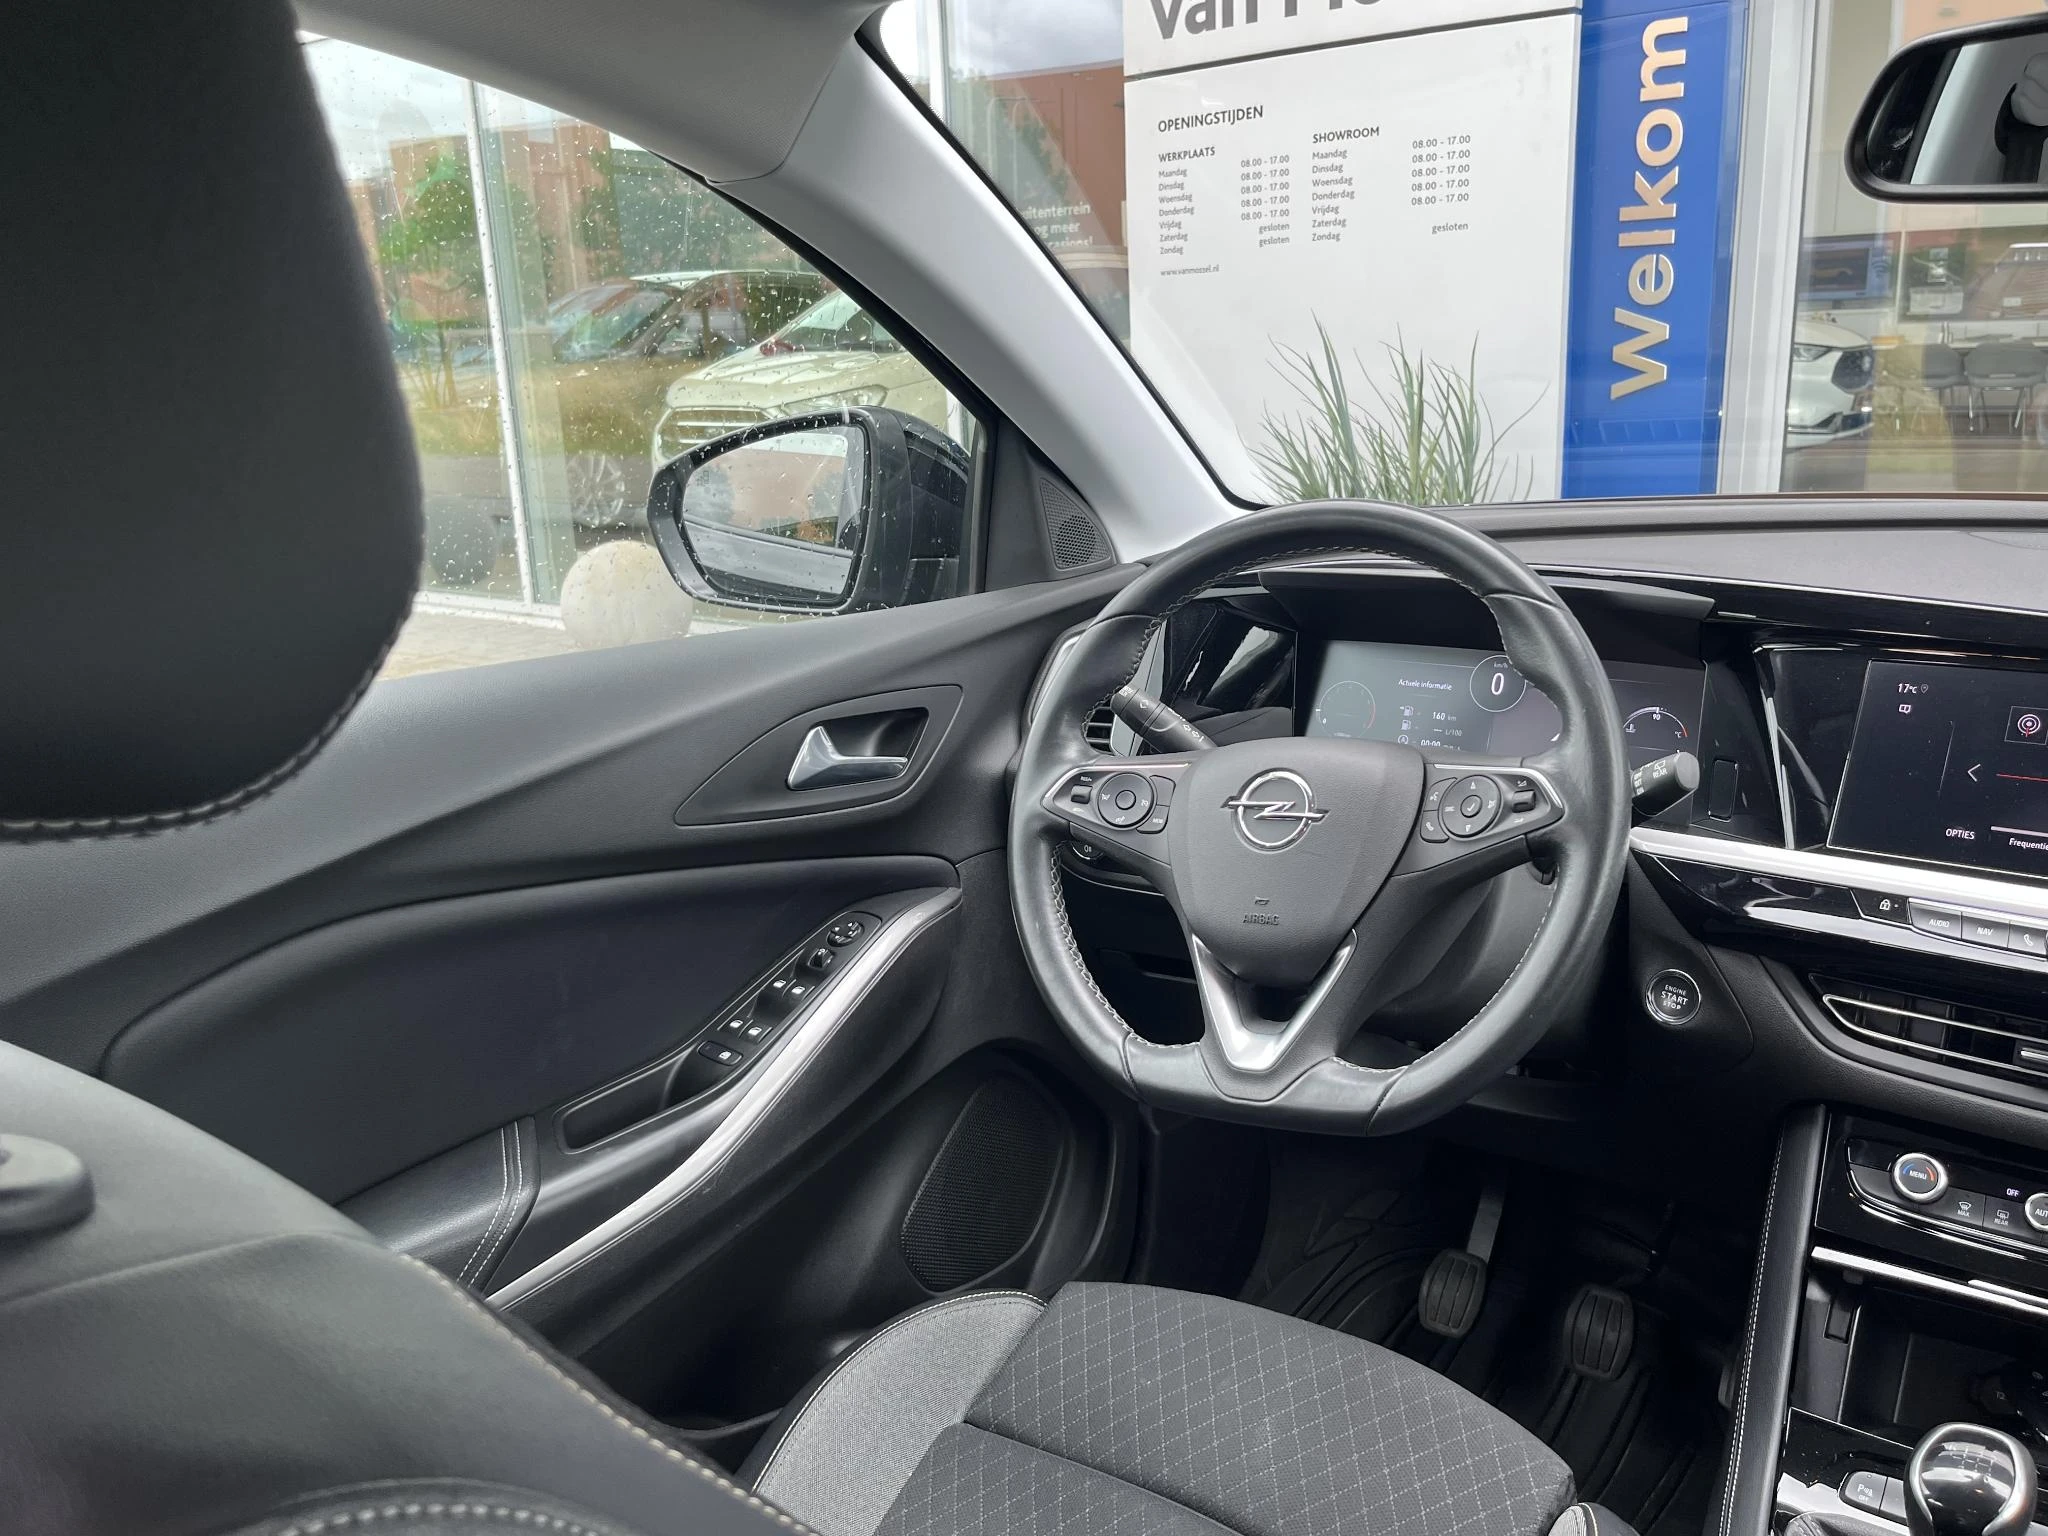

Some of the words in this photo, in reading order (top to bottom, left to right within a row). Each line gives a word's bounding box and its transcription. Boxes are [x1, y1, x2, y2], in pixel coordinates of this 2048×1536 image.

[1158, 105, 1264, 133] OPENINGSTIJDEN
[1312, 126, 1380, 144] SHOWROOM
[1158, 147, 1215, 162] WERKPLAATS
[1312, 149, 1347, 160] Maandag
[1412, 139, 1437, 149] 08.00
[1447, 135, 1470, 146] 17.00
[1312, 163, 1344, 174] Dinsdag
[1412, 153, 1437, 164] 08.00
[1447, 149, 1470, 160] 17.00
[1312, 176, 1353, 187] Woensdag
[1411, 167, 1436, 178] 08.00
[1446, 164, 1469, 175] 17.00
[1312, 190, 1355, 201] Donderdag
[1411, 182, 1436, 192] 08.00
[1446, 178, 1469, 189] 17.00
[1312, 205, 1339, 216] Vrijdag
[1411, 196, 1436, 206] 08.00
[1446, 193, 1469, 203] 17.00
[1610, 16, 1689, 400] Welkom
[1312, 217, 1347, 229] Zaterdag
[1312, 231, 1341, 242] Zondag
[1432, 222, 1469, 234] gesloten
[1398, 679, 1420, 688] Actuele
[1420, 681, 1452, 690] informatie
[1491, 672, 1504, 695] 0
[1432, 711, 1446, 721] 160
[1945, 828, 1975, 840] OPTIES
[1928, 918, 1950, 928] AUDIO
[1976, 926, 1993, 936] NAV
[1664, 984, 1687, 996] ENGINE
[1661, 991, 1689, 1006] START
[1663, 1000, 1682, 1010] STOP
[1909, 1170, 1928, 1180] MENU
[2006, 1187, 2020, 1198] OFF
[1957, 1209, 1971, 1218] MAX
